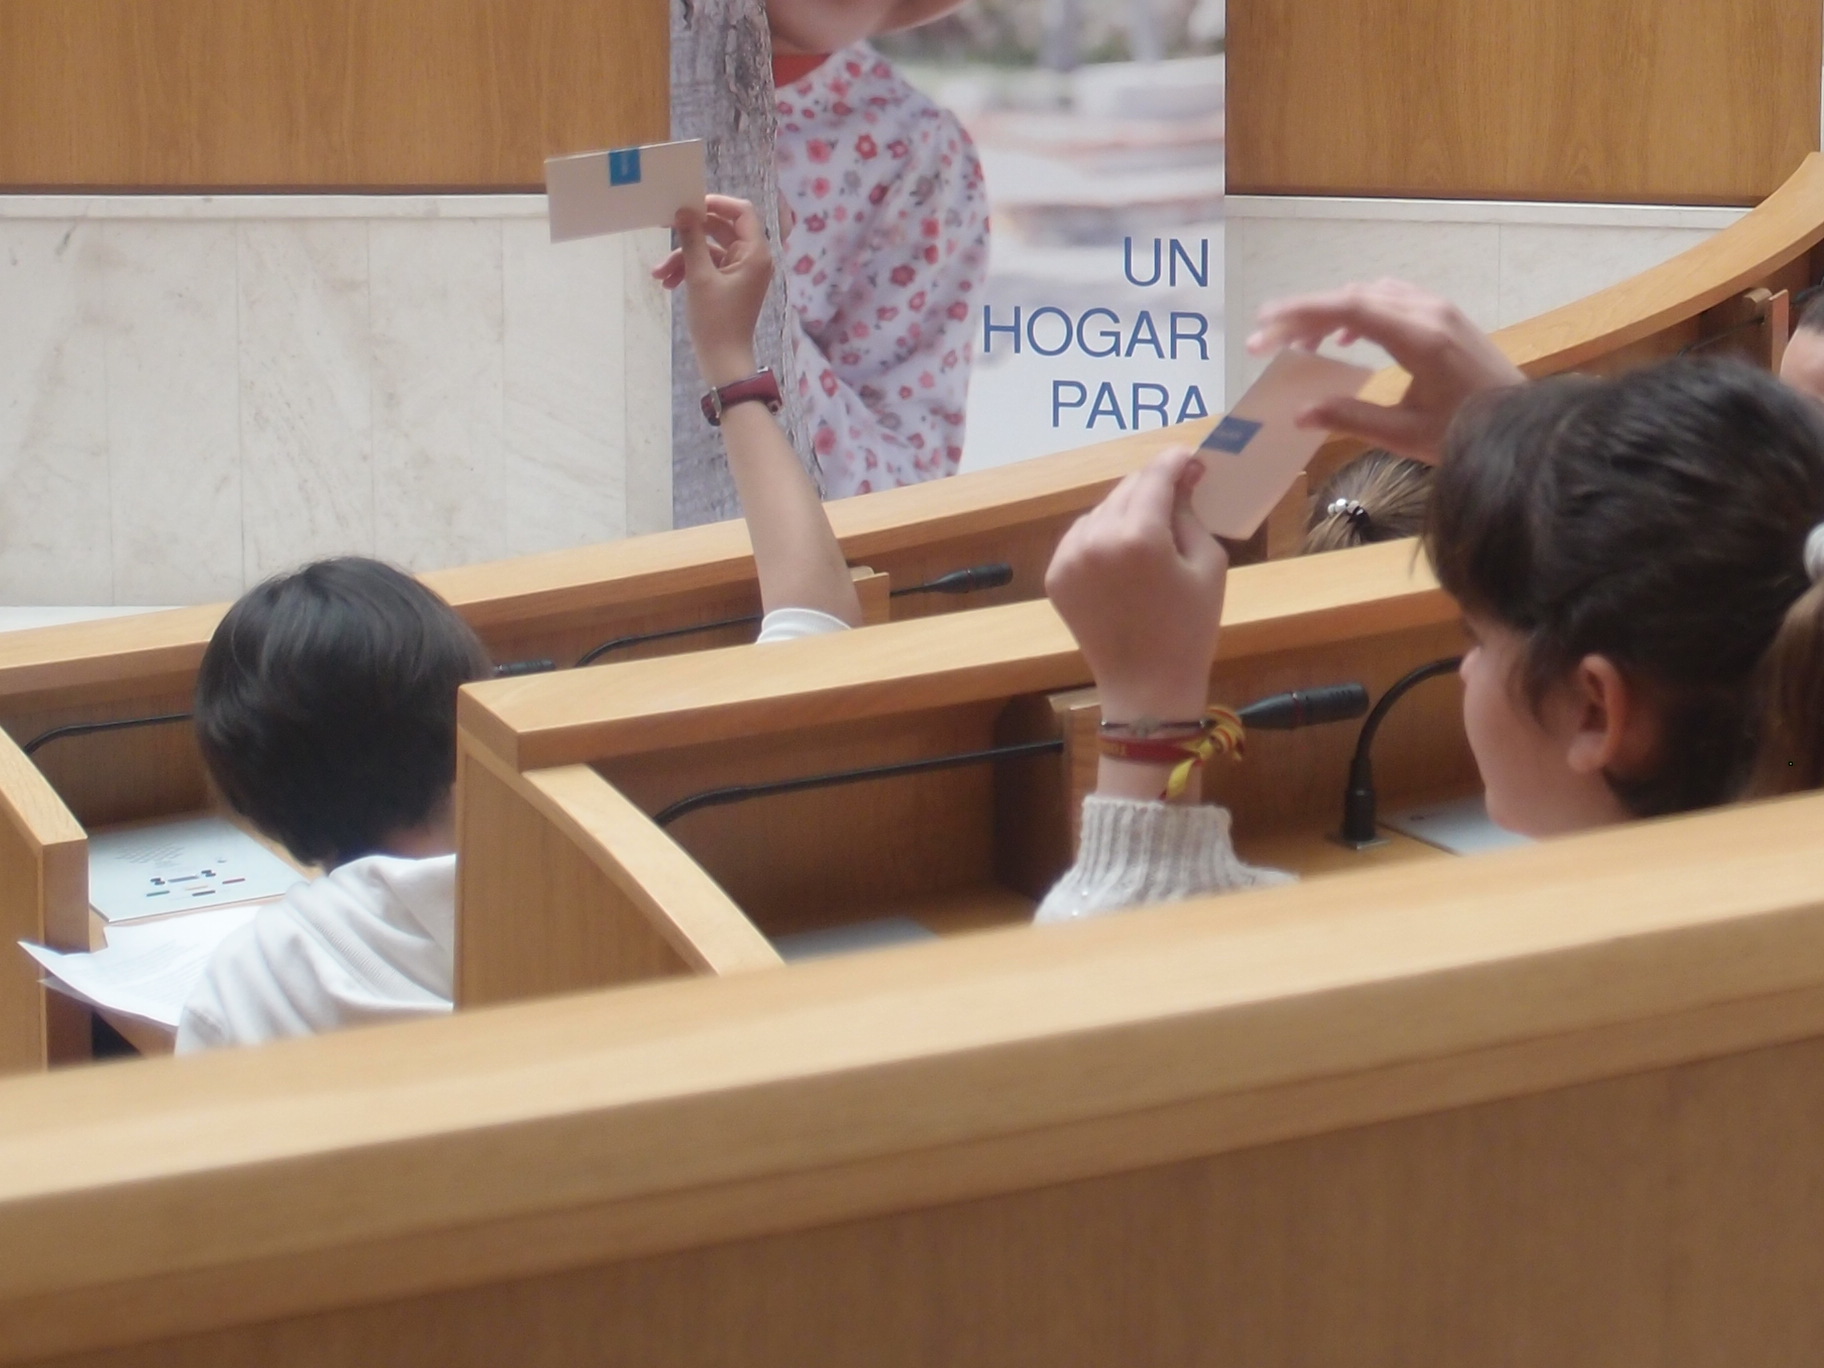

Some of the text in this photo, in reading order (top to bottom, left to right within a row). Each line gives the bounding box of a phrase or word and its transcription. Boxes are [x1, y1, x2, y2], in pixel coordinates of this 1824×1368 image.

[1123, 236, 1210, 288] UN
[982, 305, 1210, 361] HOGAR
[1052, 379, 1209, 431] PARA
